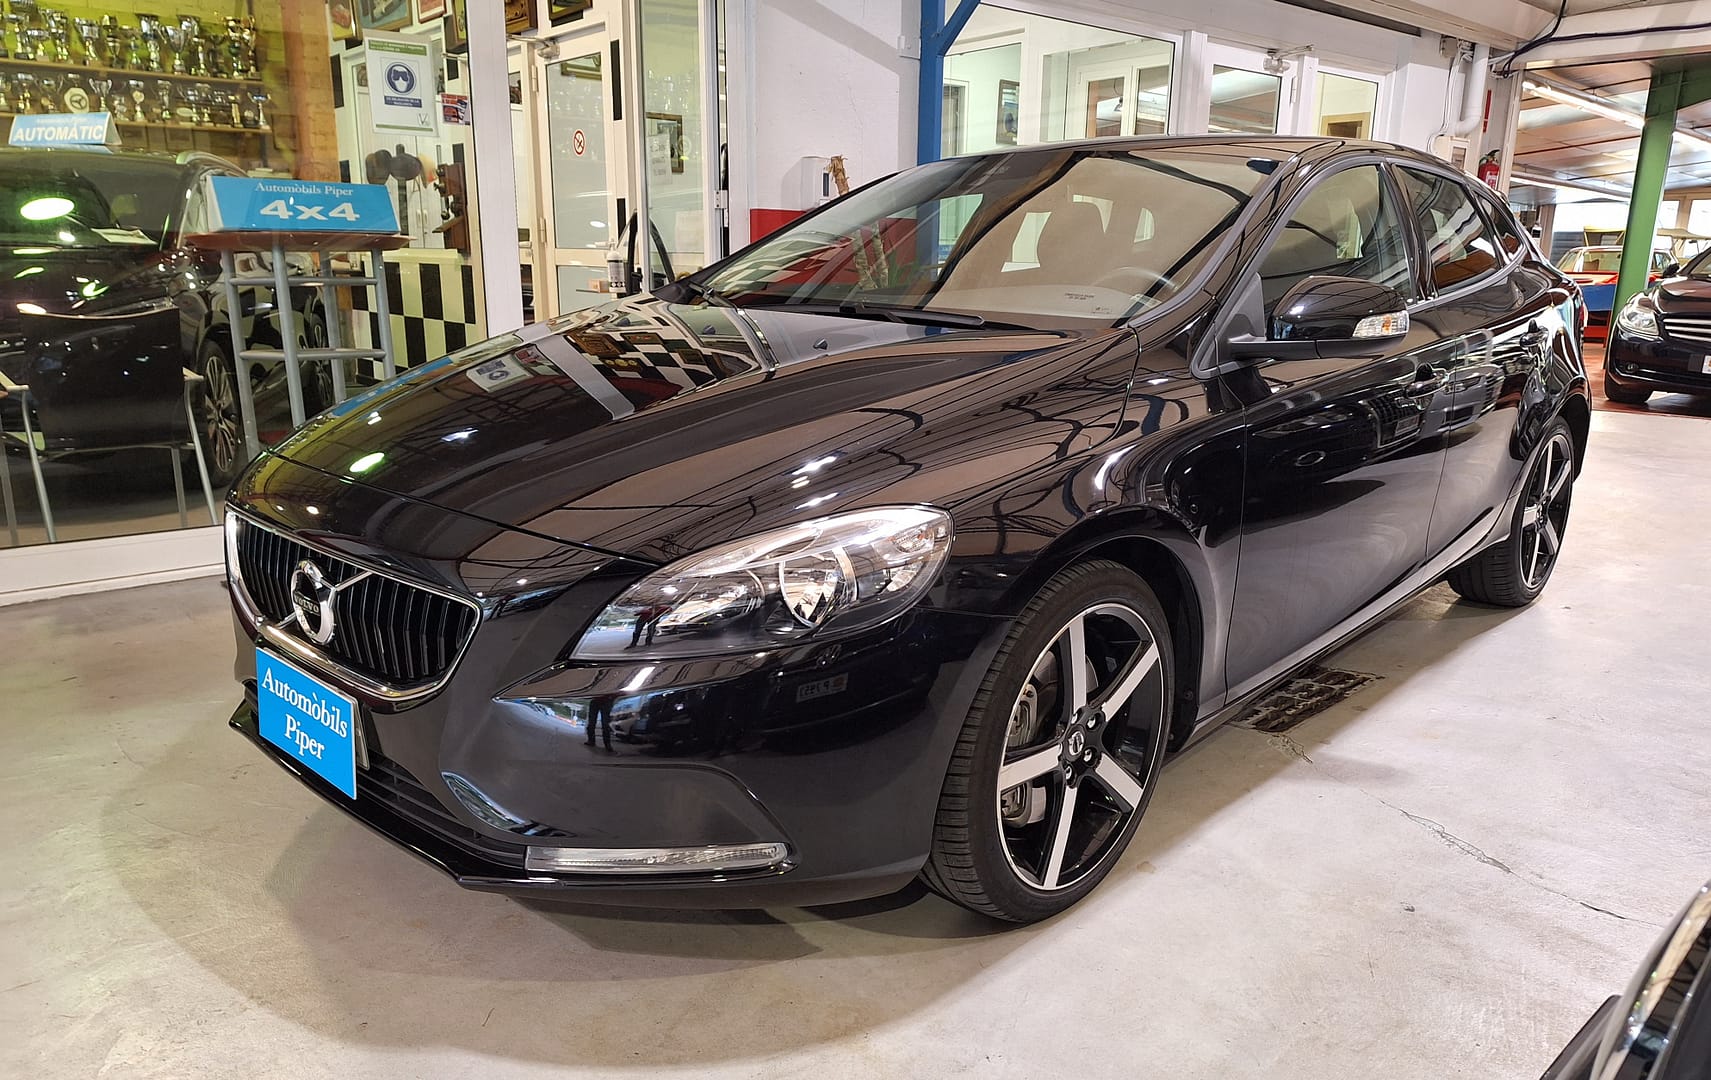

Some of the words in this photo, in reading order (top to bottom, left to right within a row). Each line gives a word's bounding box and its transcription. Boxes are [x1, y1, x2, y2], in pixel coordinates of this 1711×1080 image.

[255, 182, 322, 195] Automòbils
[324, 185, 353, 198] Piper
[260, 200, 361, 221] 4x4
[294, 593, 320, 613] VOLVO
[261, 667, 348, 738] Automòbils
[284, 714, 325, 760] Piper
